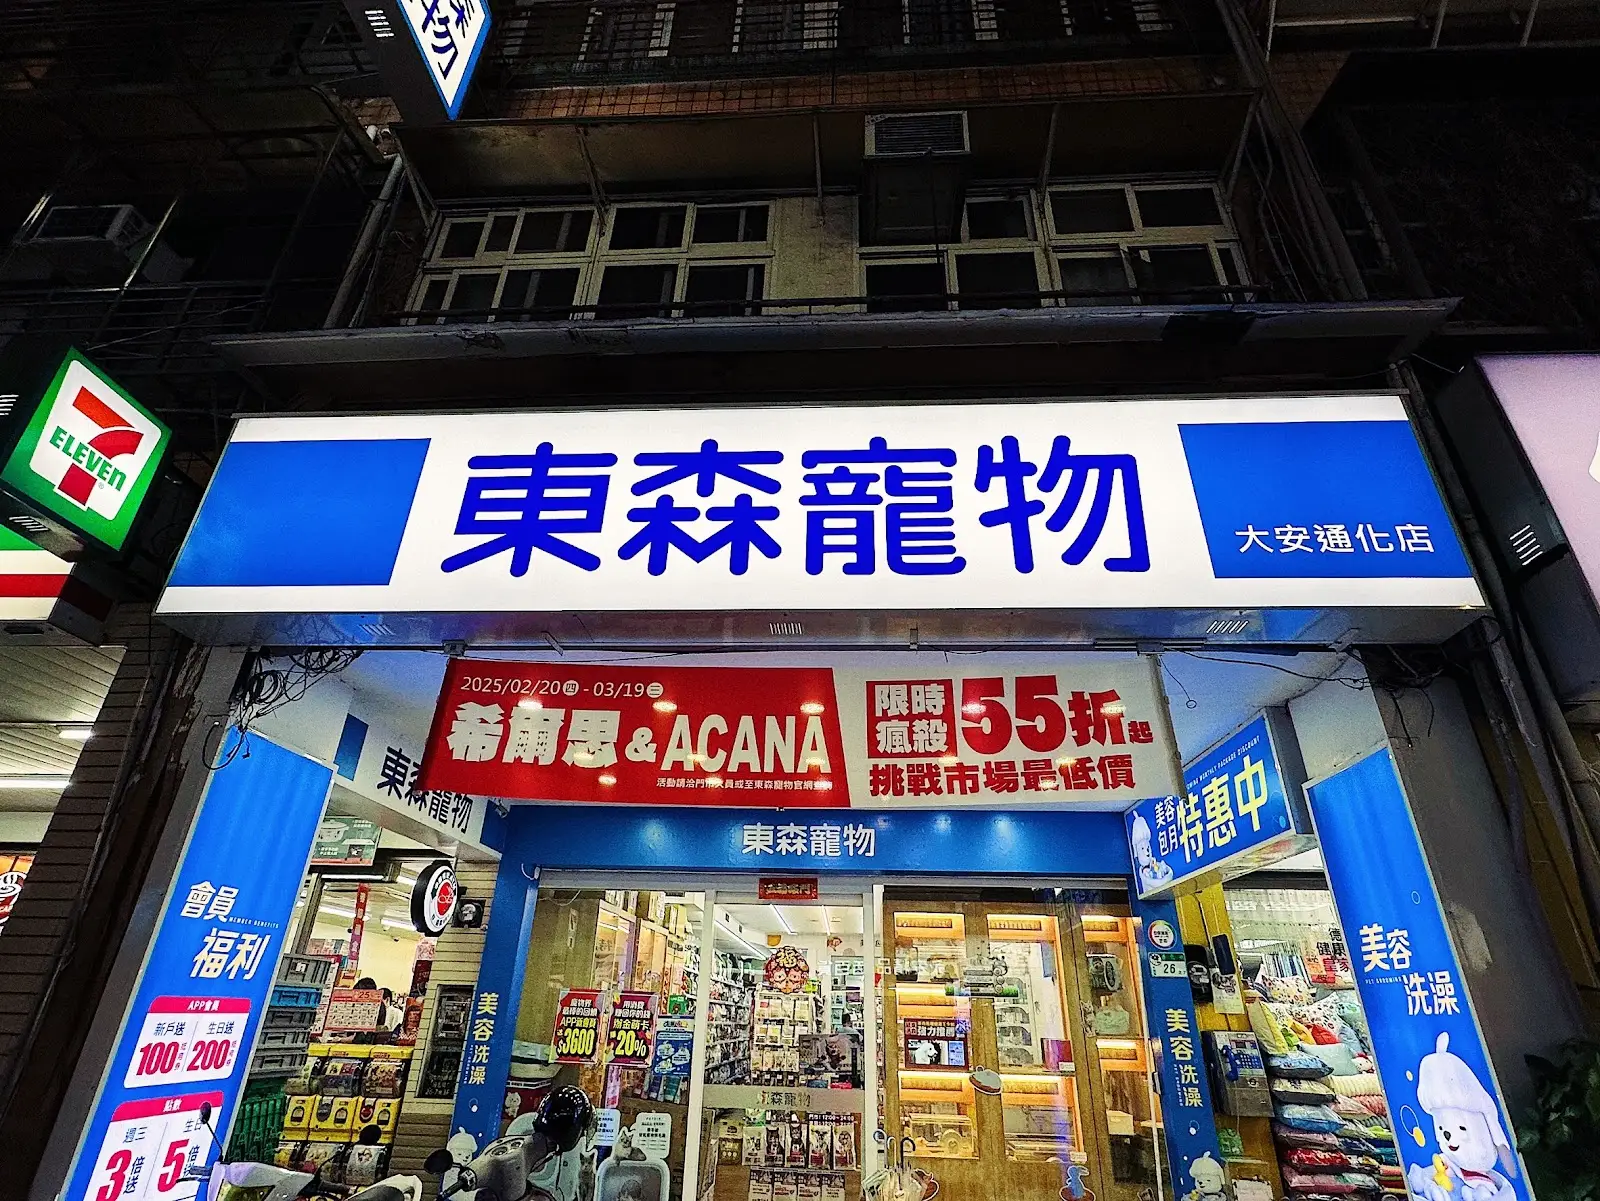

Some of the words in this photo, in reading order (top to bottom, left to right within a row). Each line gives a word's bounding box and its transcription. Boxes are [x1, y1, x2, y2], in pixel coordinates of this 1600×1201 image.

[441, 435, 1150, 577] 東森寵物
[1235, 524, 1435, 553] 大安通化店
[874, 683, 945, 717] 限時
[446, 701, 621, 769] 希爾思
[624, 726, 657, 763] &
[660, 714, 832, 774] ACANA
[876, 719, 949, 754] 瘋殺
[869, 753, 1137, 797] 挑戰市場最低價
[1154, 795, 1175, 829] 美容
[1176, 755, 1268, 863] 特惠中
[742, 822, 875, 857] 東森寵物
[1157, 825, 1179, 857] 包月
[180, 880, 240, 923] 會員
[190, 927, 272, 980] 福利
[1359, 923, 1412, 972] 美容
[1163, 963, 1176, 974] 26
[187, 1000, 221, 1011] APP會員
[1402, 970, 1460, 1015] 洗澡
[206, 1021, 235, 1035] 生日送
[468, 992, 499, 1085] 美容洗澡
[614, 1030, 647, 1057] 20%
[136, 1041, 180, 1076] 100
[187, 1039, 230, 1071] 200
[1165, 1008, 1203, 1108] 美容洗澡
[163, 1099, 182, 1113] 點數
[123, 1126, 148, 1144] 週三
[157, 1139, 190, 1193] 5
